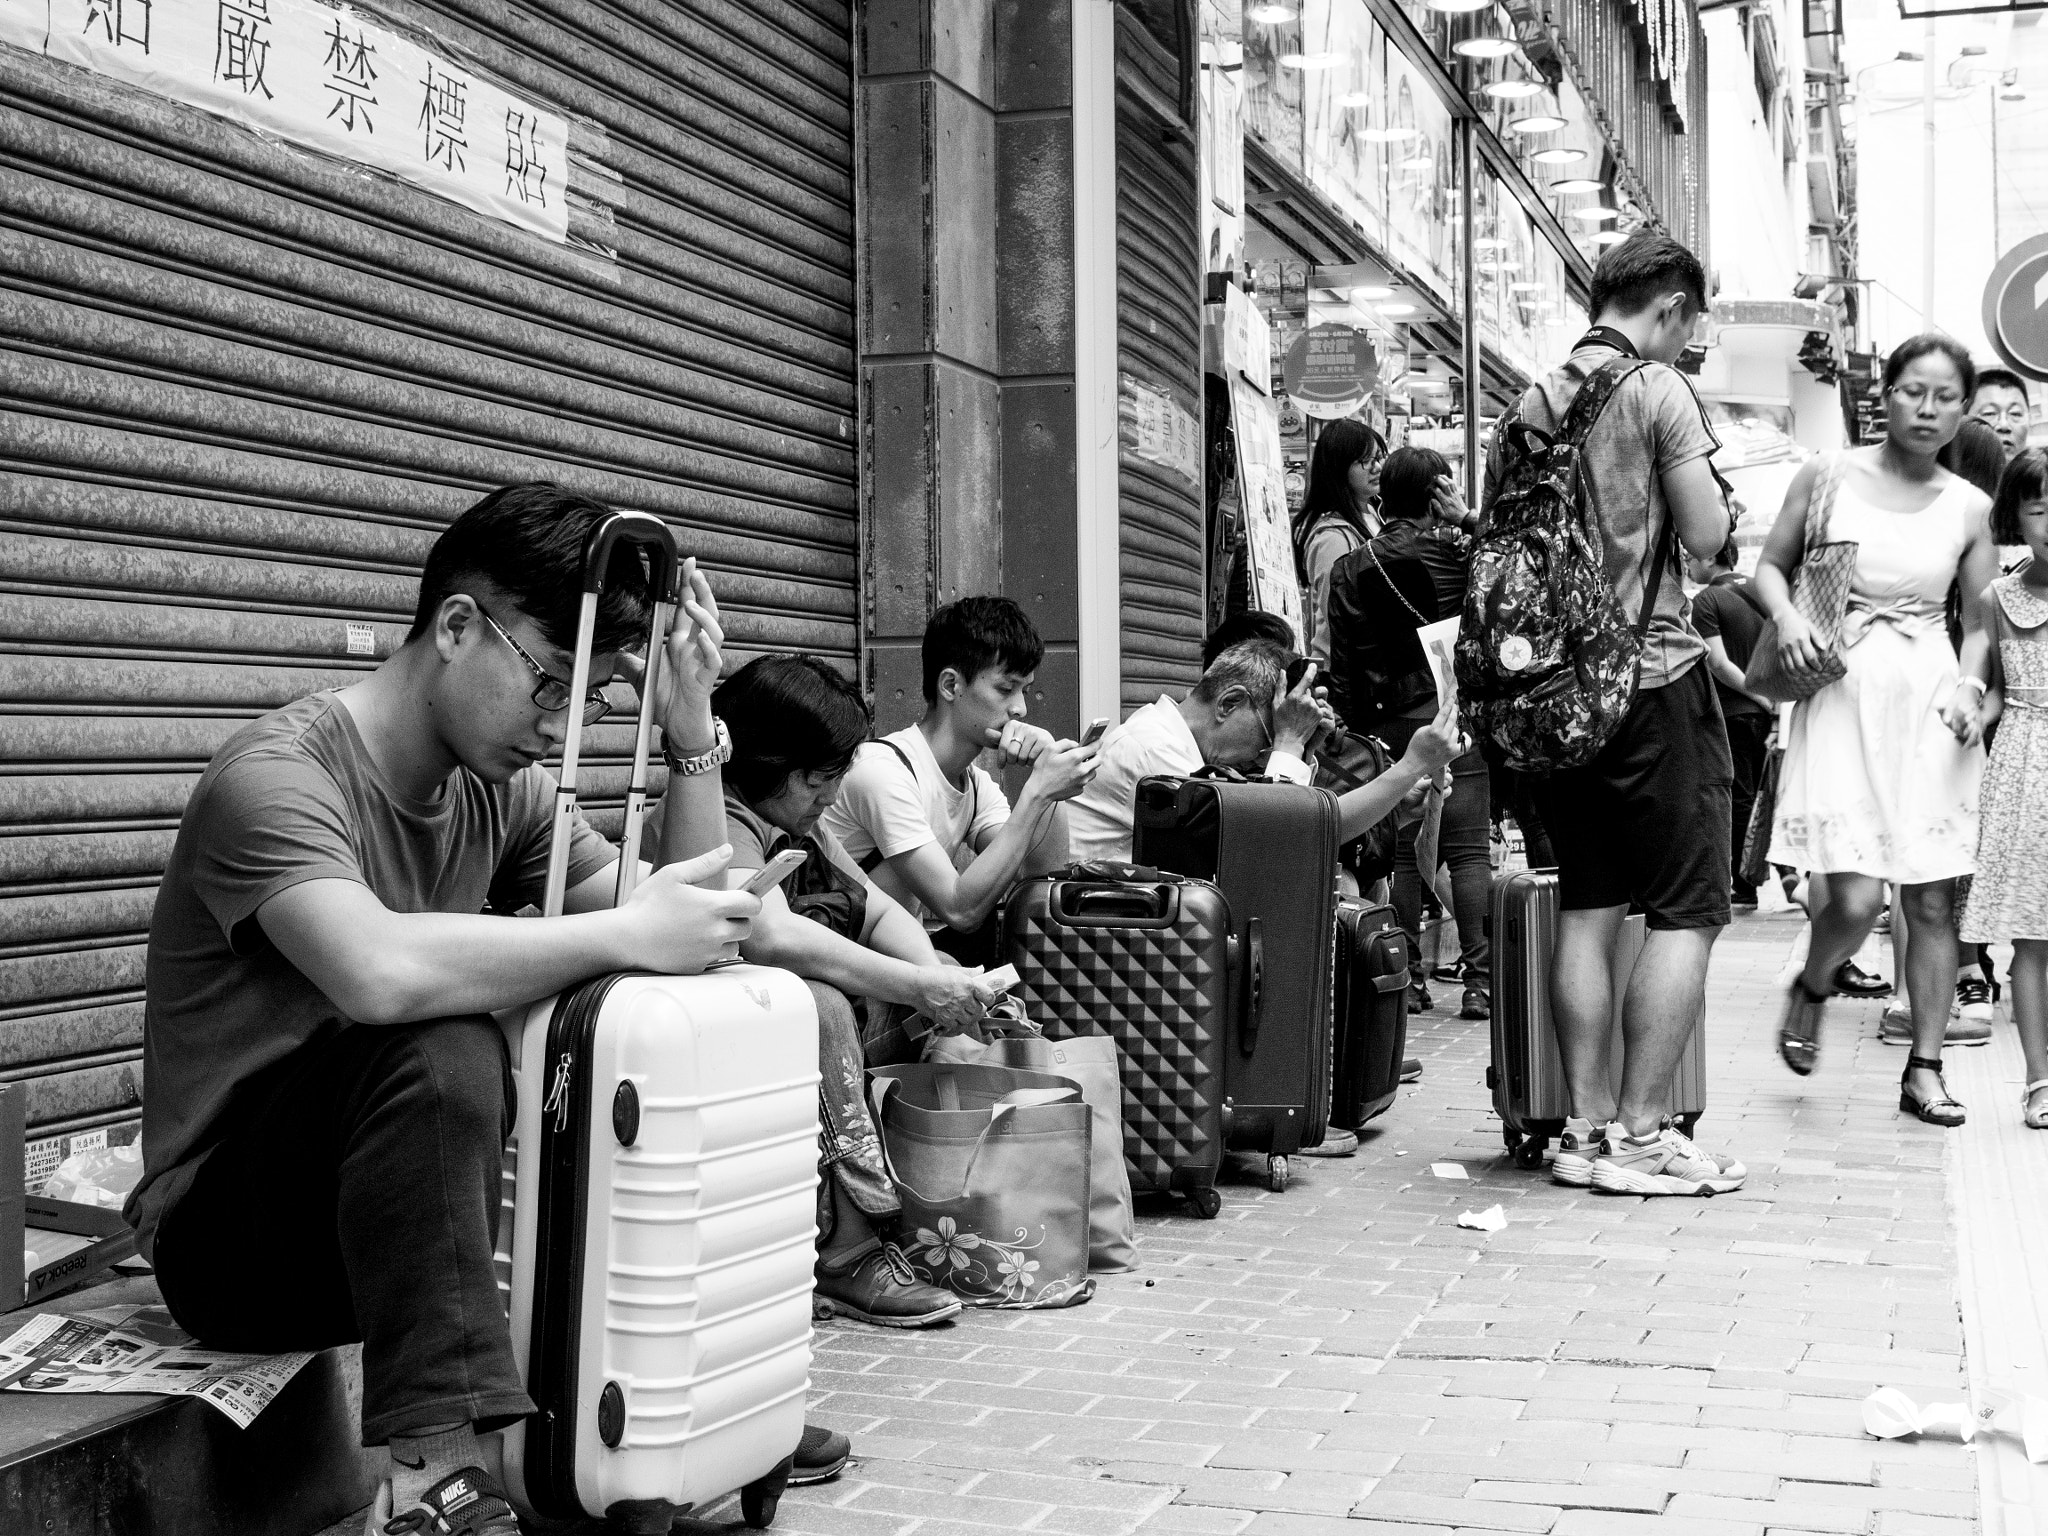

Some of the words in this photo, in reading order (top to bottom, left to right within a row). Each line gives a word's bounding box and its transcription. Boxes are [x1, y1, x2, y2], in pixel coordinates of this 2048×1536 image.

[30, 1156, 60, 1169] 24273657
[48, 1254, 87, 1281] Reebok
[440, 1479, 468, 1506] NIKE
